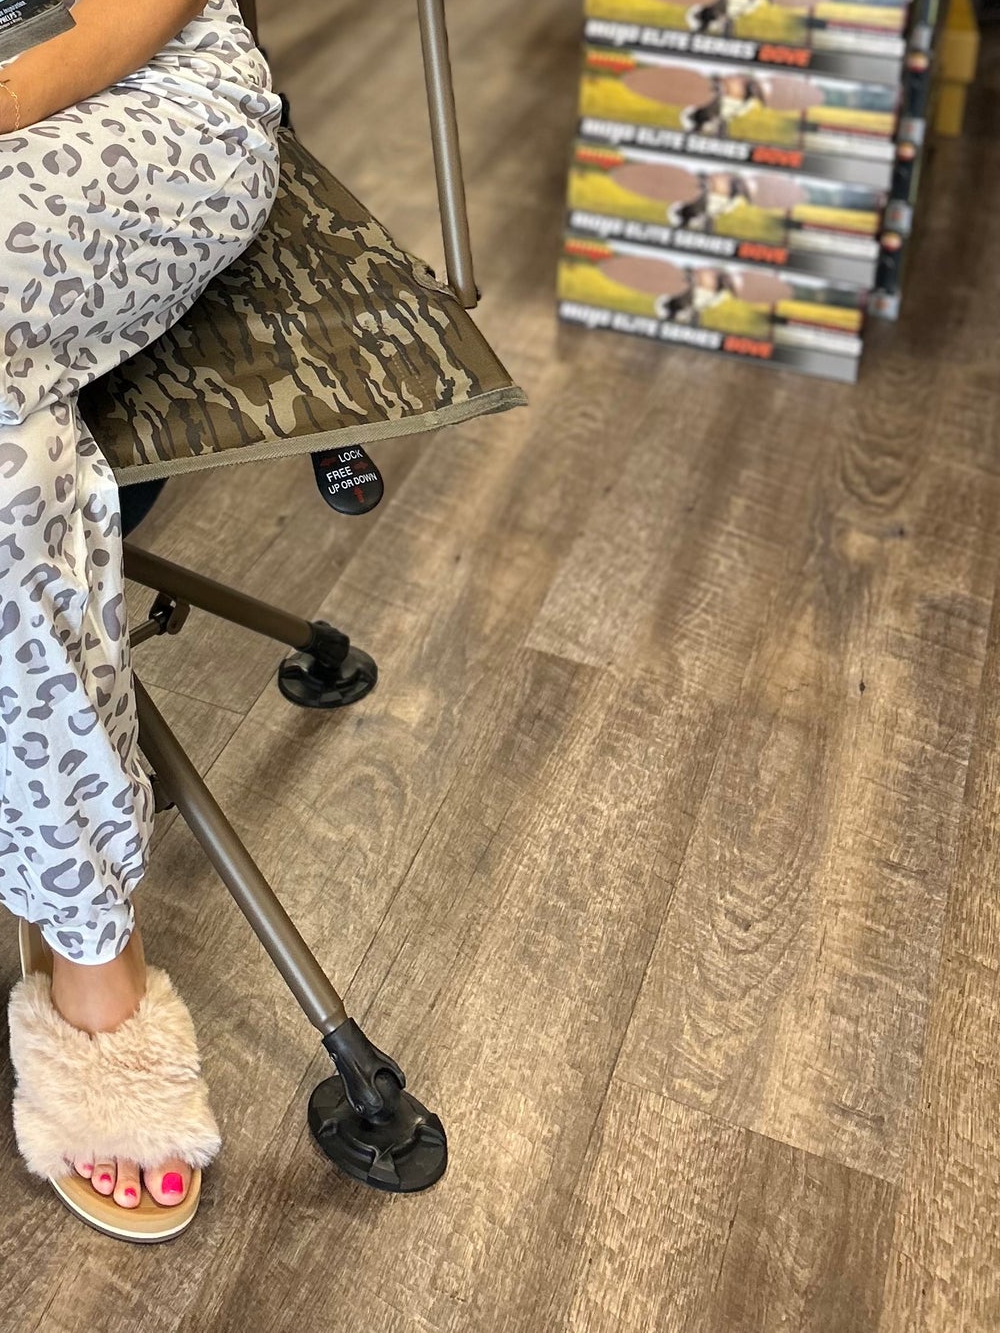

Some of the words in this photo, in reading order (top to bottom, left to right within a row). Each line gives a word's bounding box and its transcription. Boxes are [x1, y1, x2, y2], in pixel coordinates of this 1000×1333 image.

[641, 26, 690, 49] ELITE
[691, 33, 758, 60] SERIES
[758, 44, 812, 67] DOVE
[636, 127, 685, 149] ELITE
[686, 133, 751, 160] SERIES
[751, 145, 803, 167] DOVE
[624, 220, 671, 243] ELITE
[673, 228, 736, 256] SERIES
[736, 241, 788, 264] DOVE
[612, 311, 659, 336] ELITE
[660, 320, 723, 348] SERIES
[723, 335, 773, 358] DOVE
[326, 466, 353, 482] FREE
[338, 449, 363, 463] LOCK
[327, 483, 340, 495] UP
[341, 479, 355, 489] OR
[353, 472, 378, 485] DOWN
